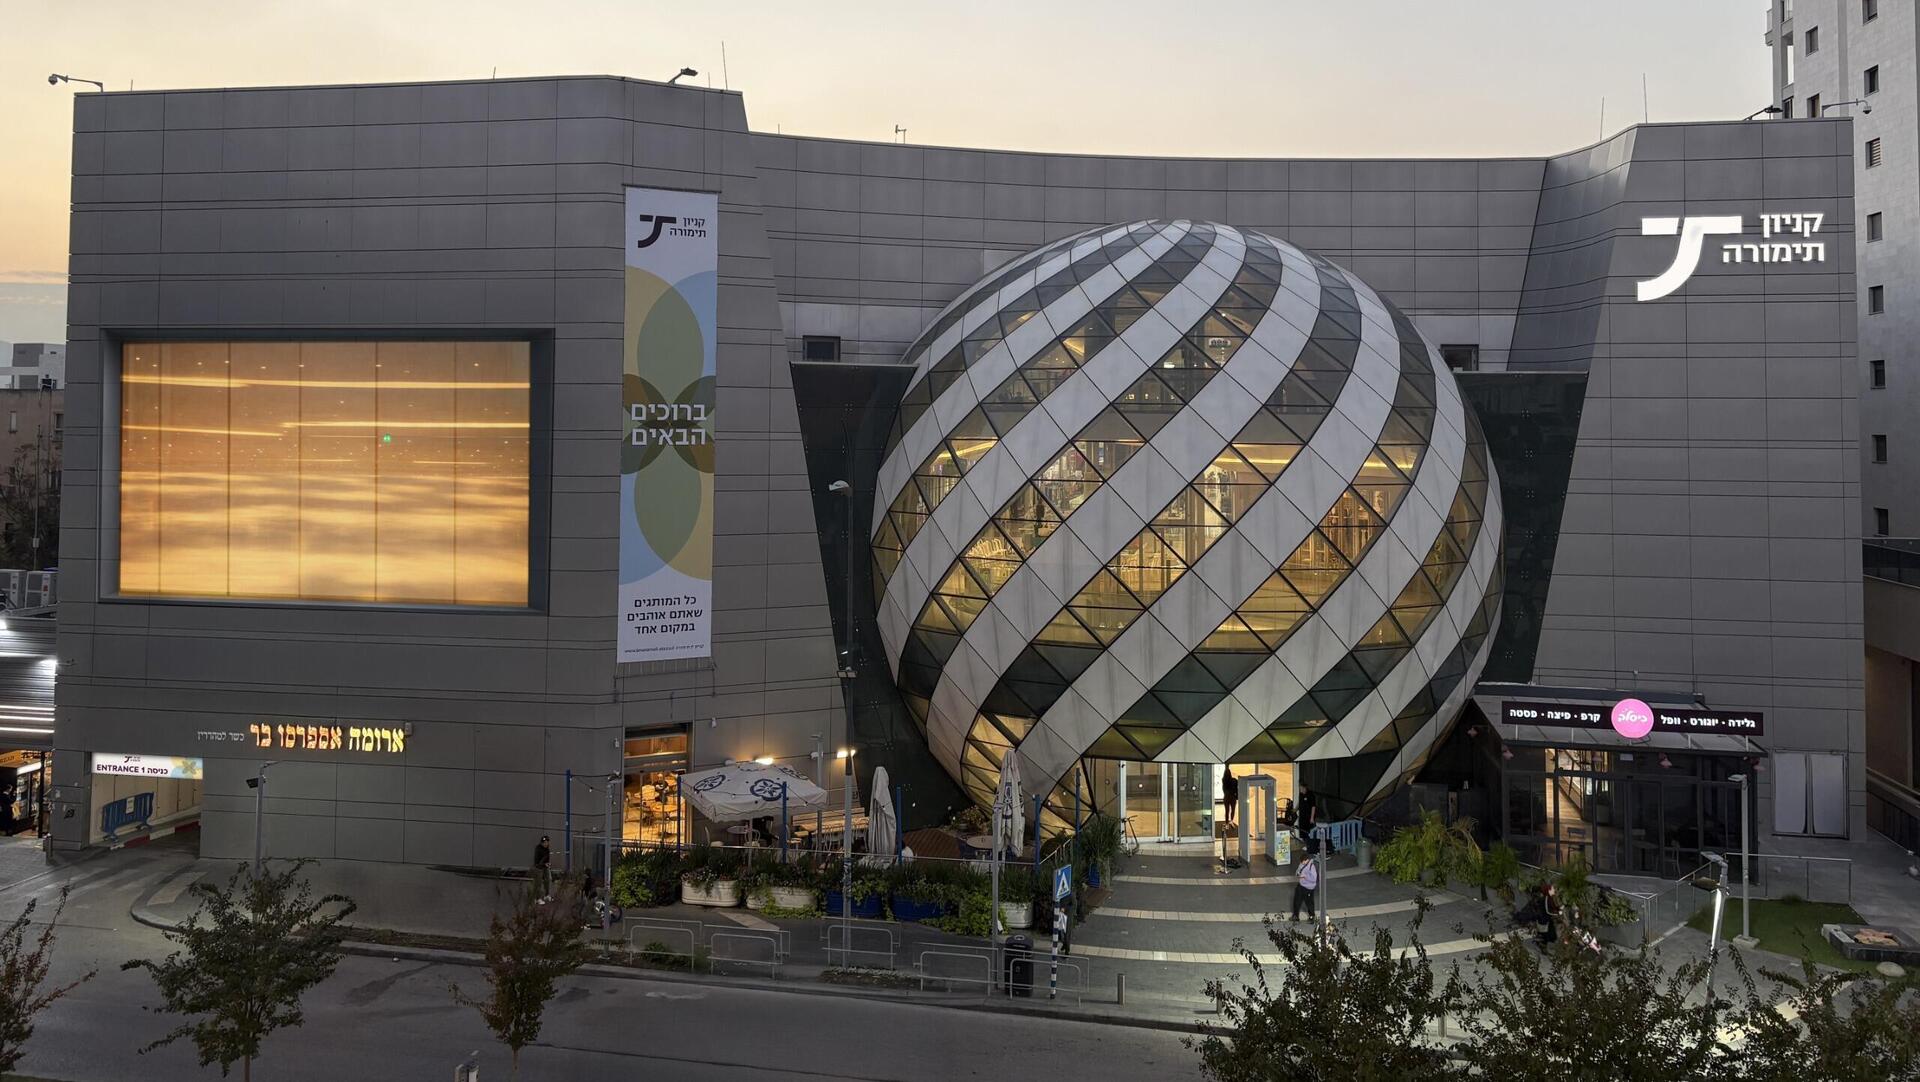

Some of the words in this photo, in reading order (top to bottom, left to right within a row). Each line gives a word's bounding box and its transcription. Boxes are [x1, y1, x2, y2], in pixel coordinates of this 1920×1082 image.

[683, 217, 705, 227] קניון
[1760, 213, 1824, 238] קניון
[670, 228, 706, 237] תימורה
[1722, 243, 1825, 263] תימורה
[631, 403, 707, 421] ברוכים
[631, 428, 706, 446] הבאים
[634, 597, 680, 608] המותגים
[684, 595, 696, 605] כל
[627, 611, 666, 622] אוהבים
[669, 609, 703, 619] שאתם
[634, 625, 657, 635] אחד
[660, 623, 695, 634] במקום
[1509, 709, 1538, 718] פסטה
[1547, 711, 1571, 720] פיצה
[1580, 713, 1601, 723] קרפ
[1660, 715, 1681, 725] וופל
[1728, 718, 1756, 728] גלידה
[229, 732, 244, 742] כשר
[250, 723, 272, 748] בר
[278, 724, 342, 750] אספרסו
[349, 726, 404, 752] ארומה
[96, 763, 139, 773] ENTRANCE
[147, 767, 169, 775] כניסה
